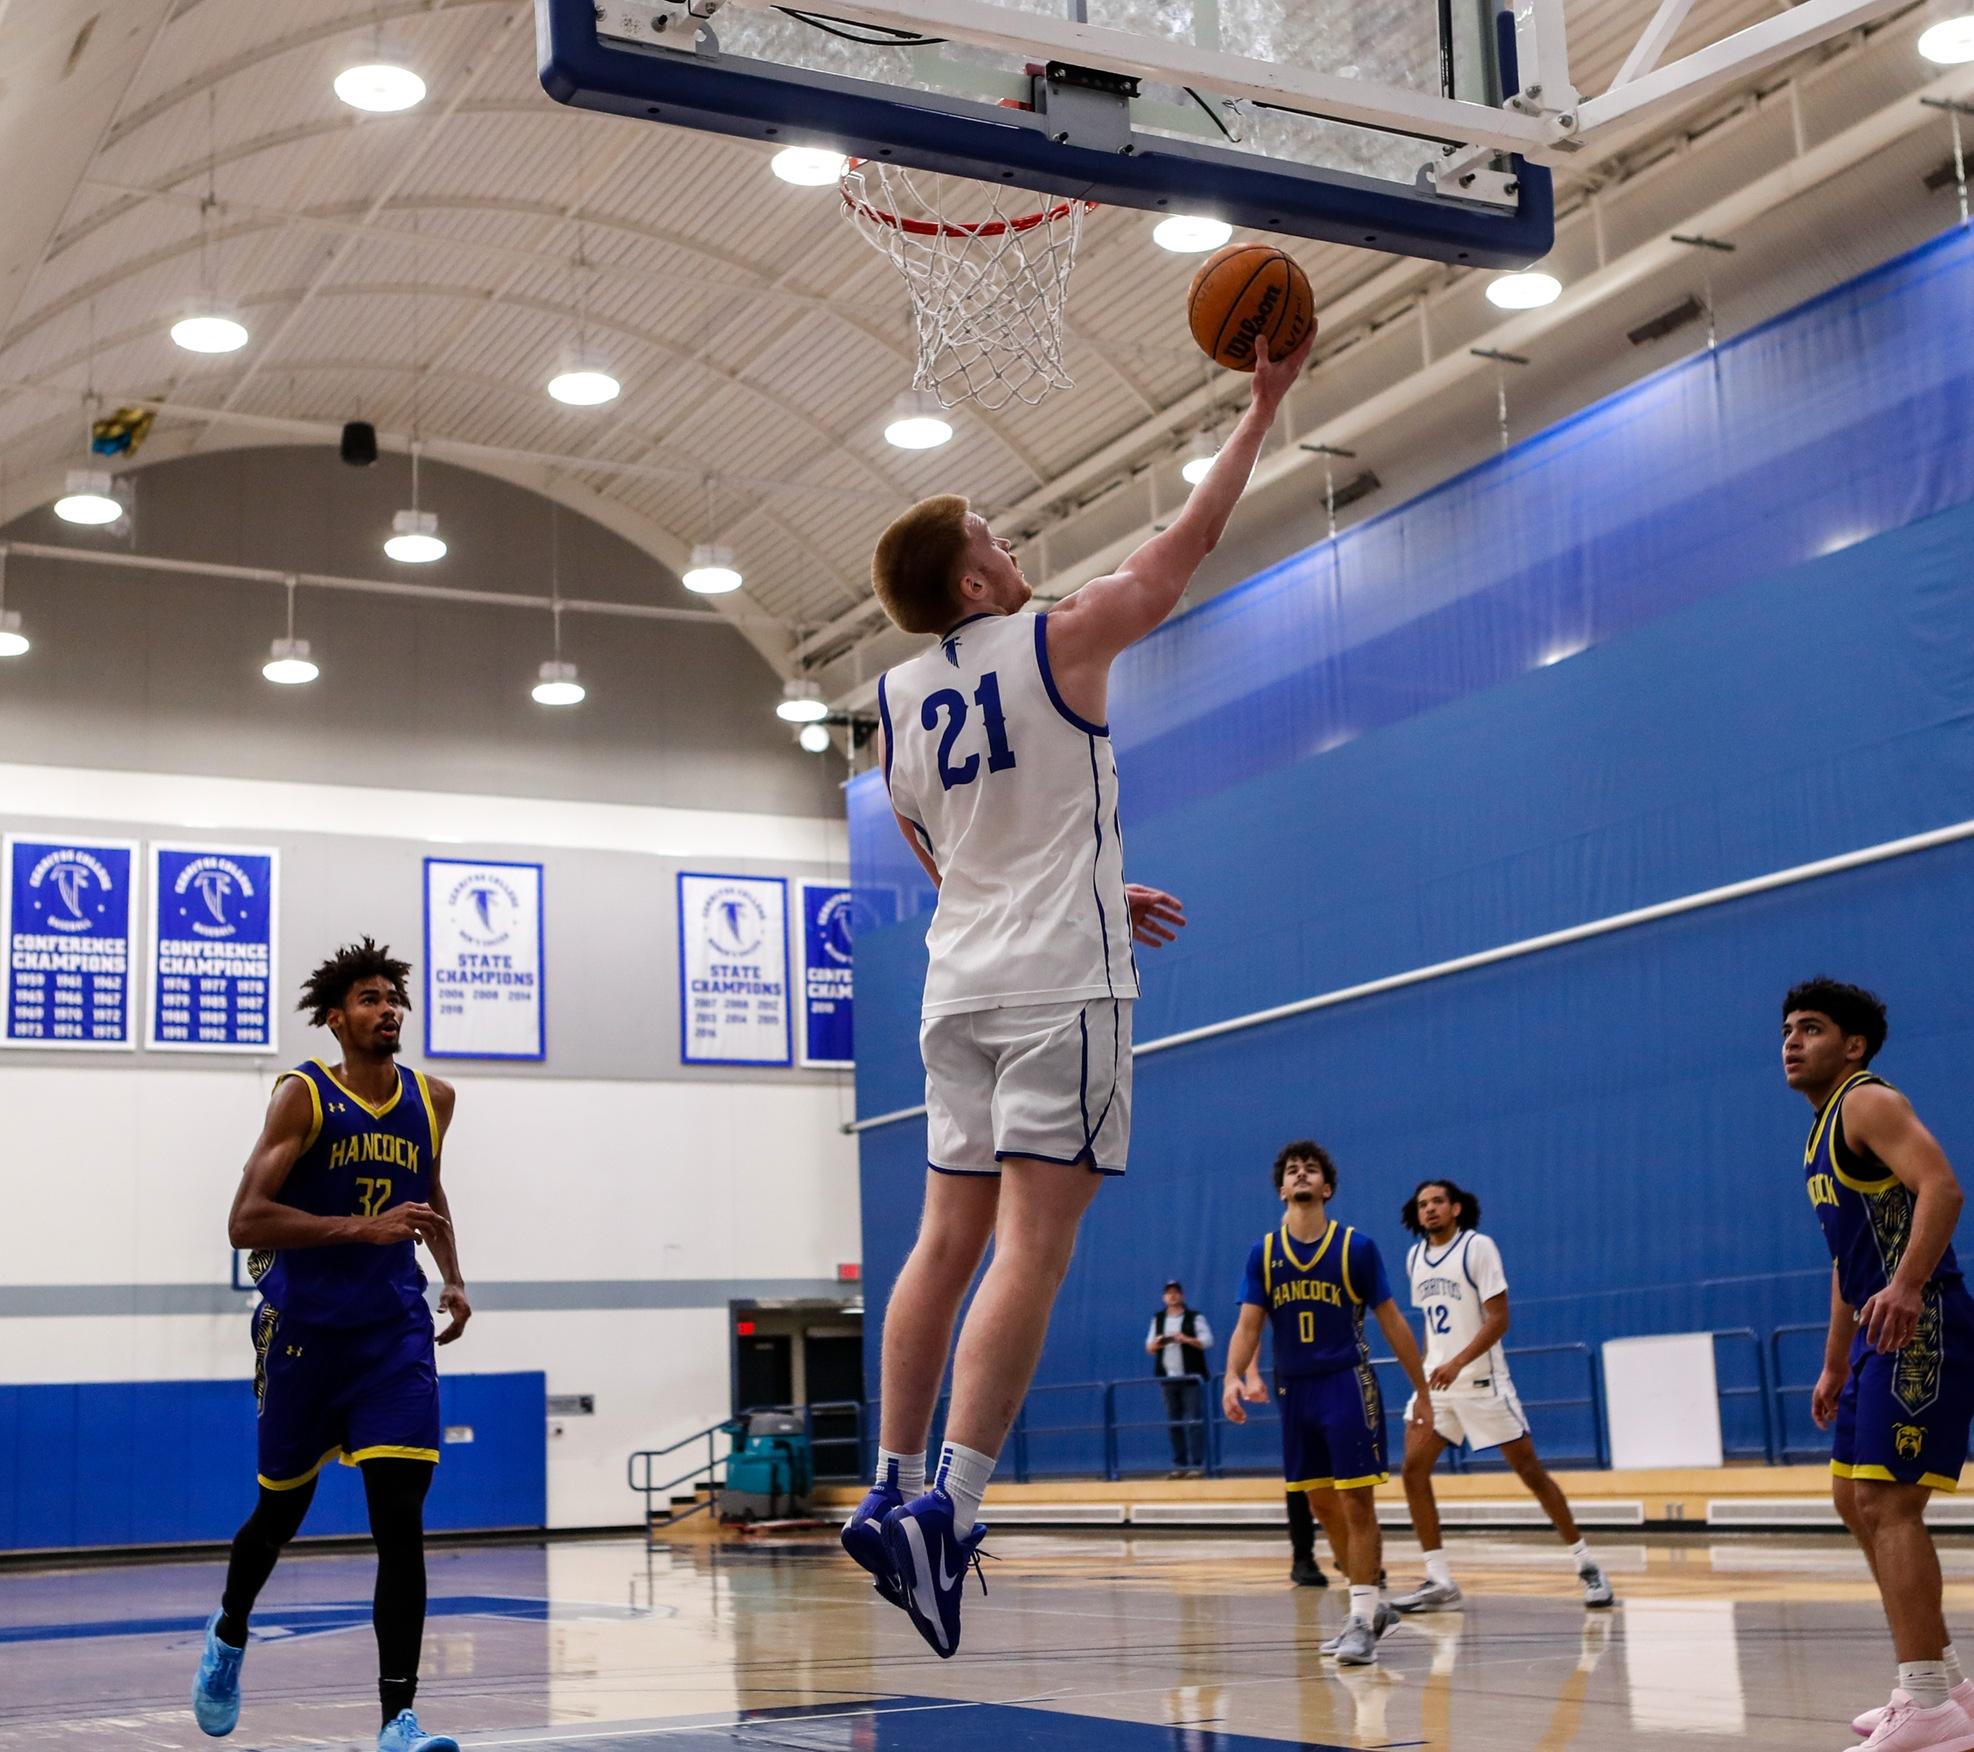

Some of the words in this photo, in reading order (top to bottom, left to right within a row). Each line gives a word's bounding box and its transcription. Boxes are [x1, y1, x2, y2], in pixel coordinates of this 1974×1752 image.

[1225, 285, 1281, 359] Wilson
[921, 671, 1016, 791] 21
[13, 934, 127, 954] CONFERENCE
[160, 939, 268, 960] CONFERENCE
[12, 952, 126, 973] CHAMPIONS
[159, 957, 268, 978] CHAMPIONS
[458, 954, 513, 969] STATE
[710, 965, 761, 979] STATE
[436, 970, 534, 986] CHAMPIONS
[692, 980, 781, 995] CHAMPIONS
[329, 1133, 419, 1174] HANCOCK
[352, 1177, 392, 1217] 32
[1273, 1280, 1342, 1309] HANCOCK
[1299, 1311, 1314, 1343] 0
[1427, 1304, 1452, 1335] 12
